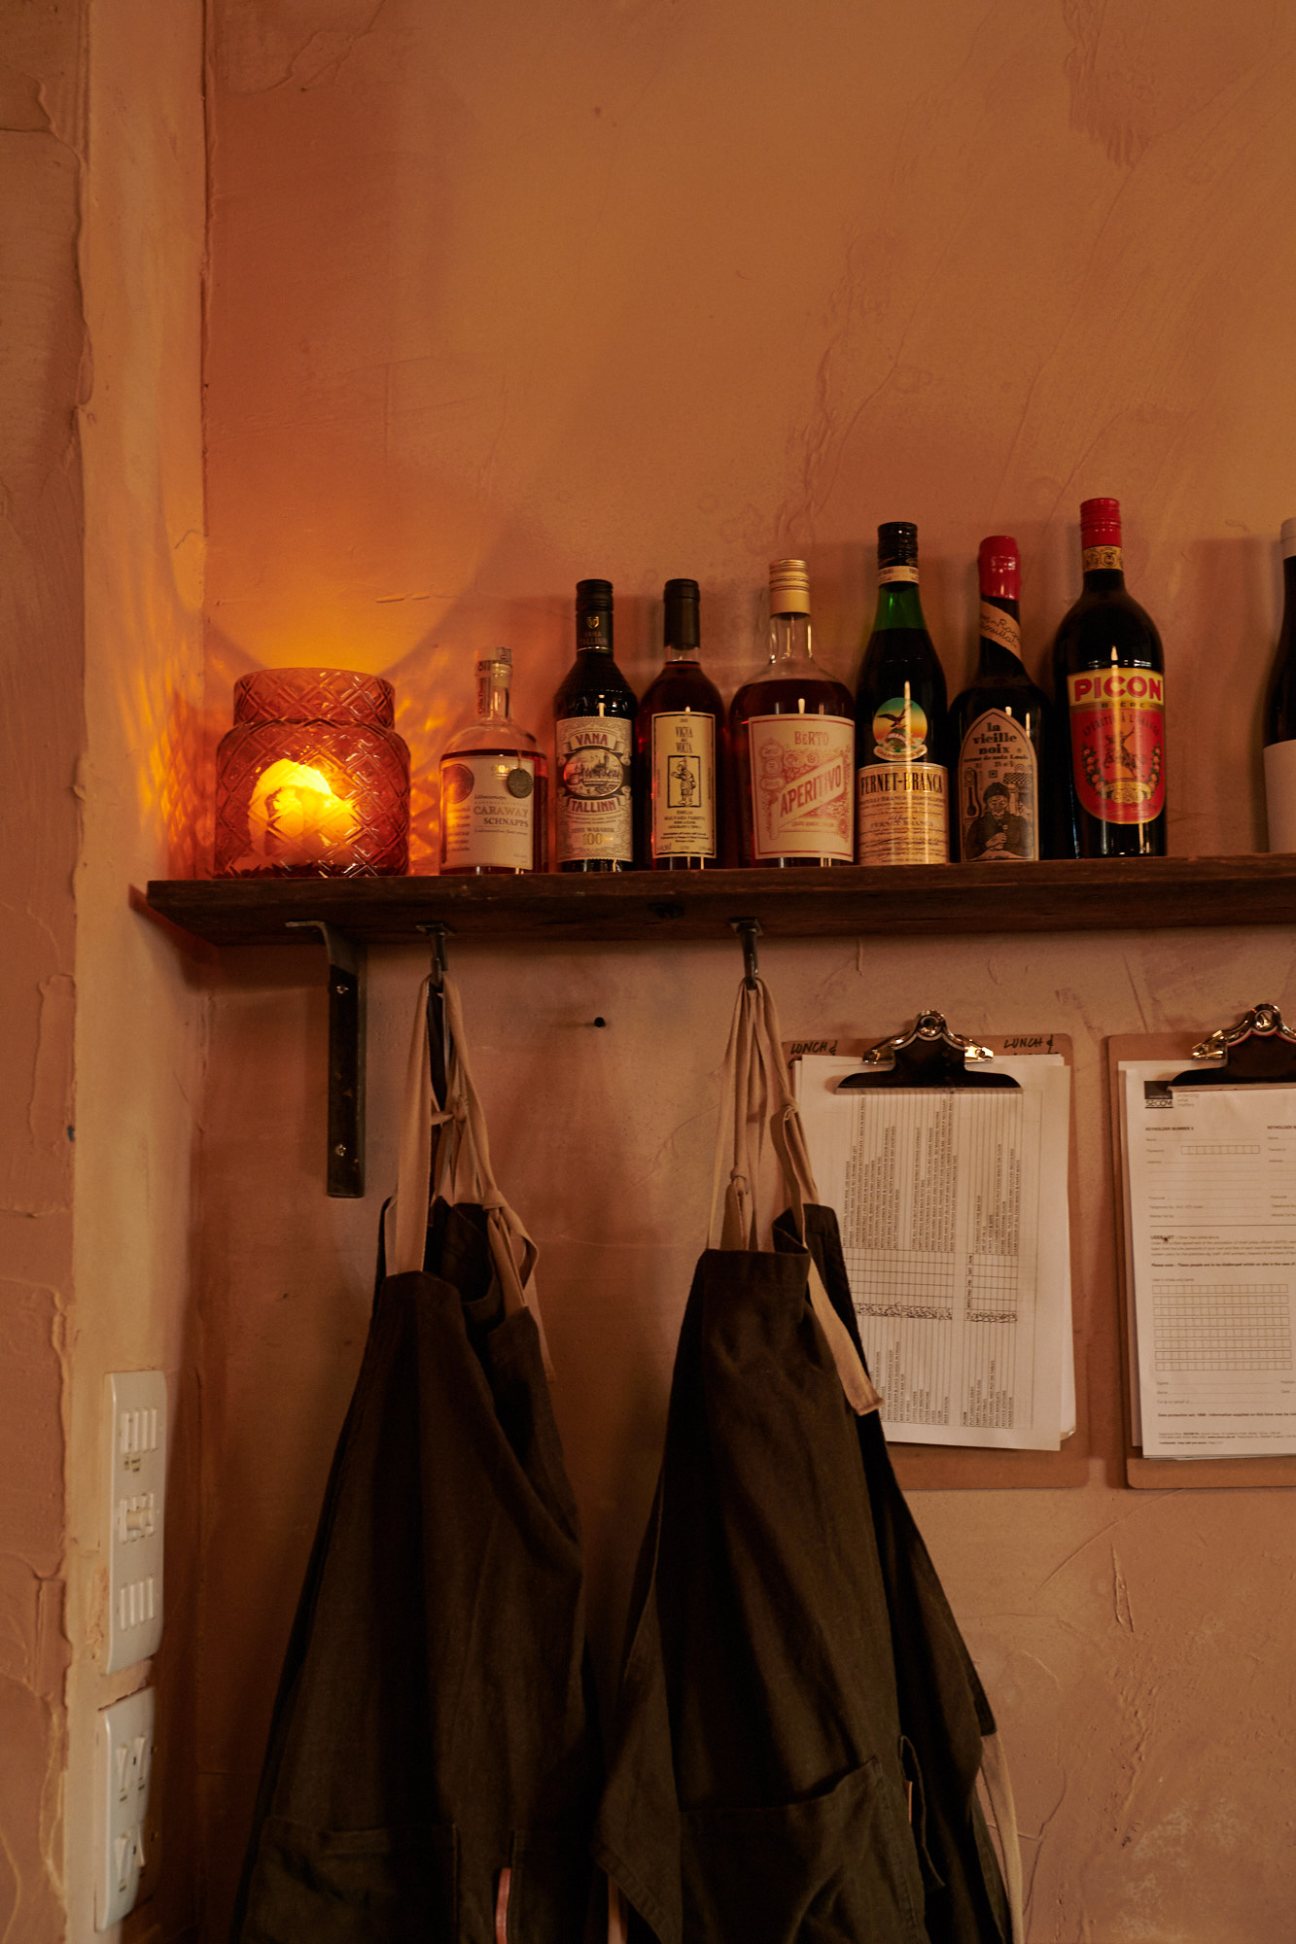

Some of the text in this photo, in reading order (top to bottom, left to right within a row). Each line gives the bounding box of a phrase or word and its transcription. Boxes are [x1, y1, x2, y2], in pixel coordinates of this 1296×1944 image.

[1074, 676, 1162, 702] PICON
[575, 732, 609, 747] VANA
[972, 733, 1017, 745] vieille
[978, 744, 1009, 755] noix
[861, 772, 943, 796] FERNET-BRANCA
[780, 765, 841, 818] APERITIVO
[473, 806, 529, 818] CARAWAY
[570, 800, 616, 813] TALLINN
[483, 817, 529, 828] SCHNAPPS
[790, 1040, 828, 1055] LUNCH
[1003, 1037, 1043, 1049] LUNCH
